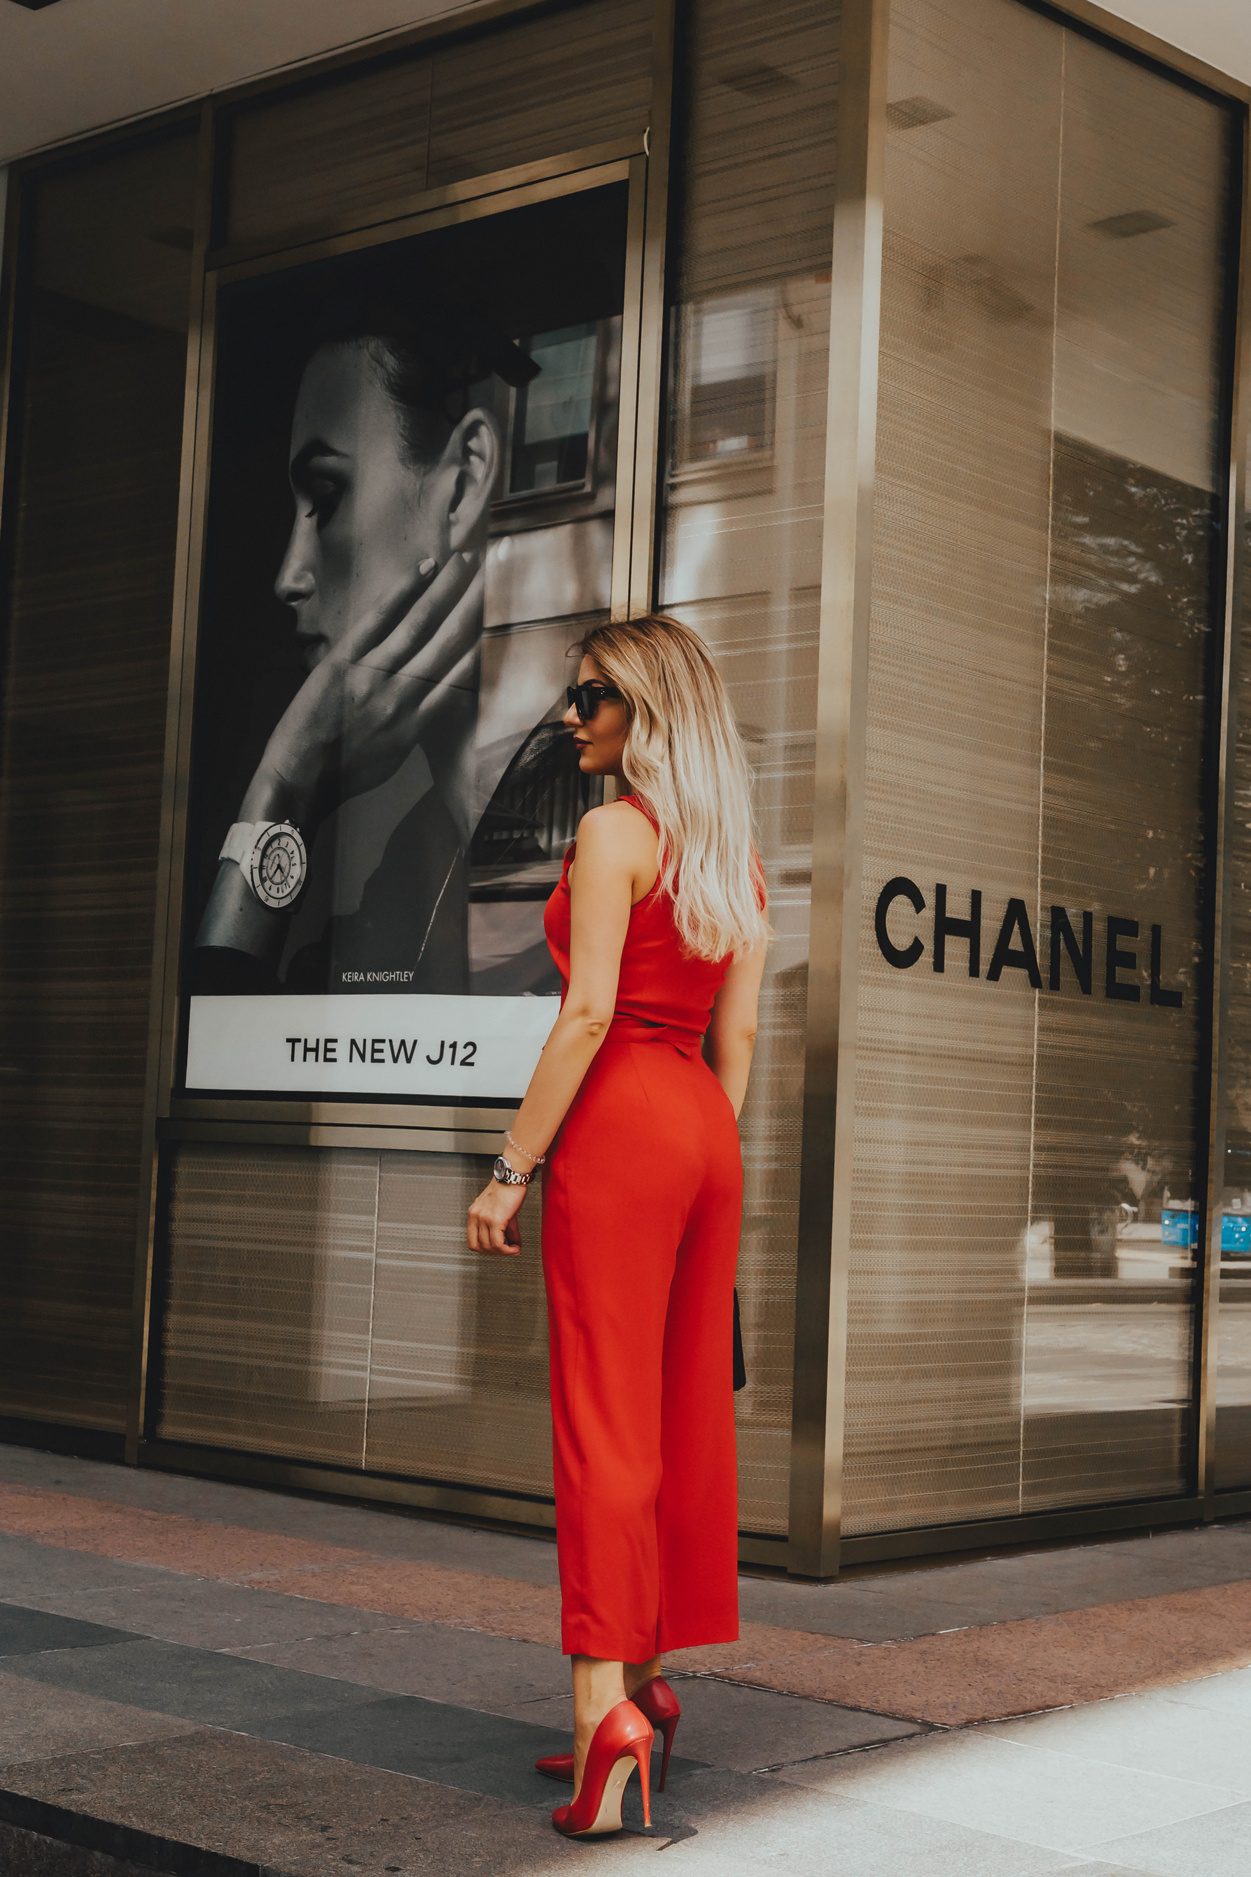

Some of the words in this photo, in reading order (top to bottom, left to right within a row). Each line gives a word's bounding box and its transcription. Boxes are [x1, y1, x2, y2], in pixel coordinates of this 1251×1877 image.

[874, 876, 1183, 1008] CHANEL
[342, 971, 365, 982] KEIRA
[366, 970, 415, 982] KNIGHTLEY
[285, 1037, 339, 1063] THE
[348, 1038, 418, 1064] NEW
[425, 1040, 478, 1067] J12
